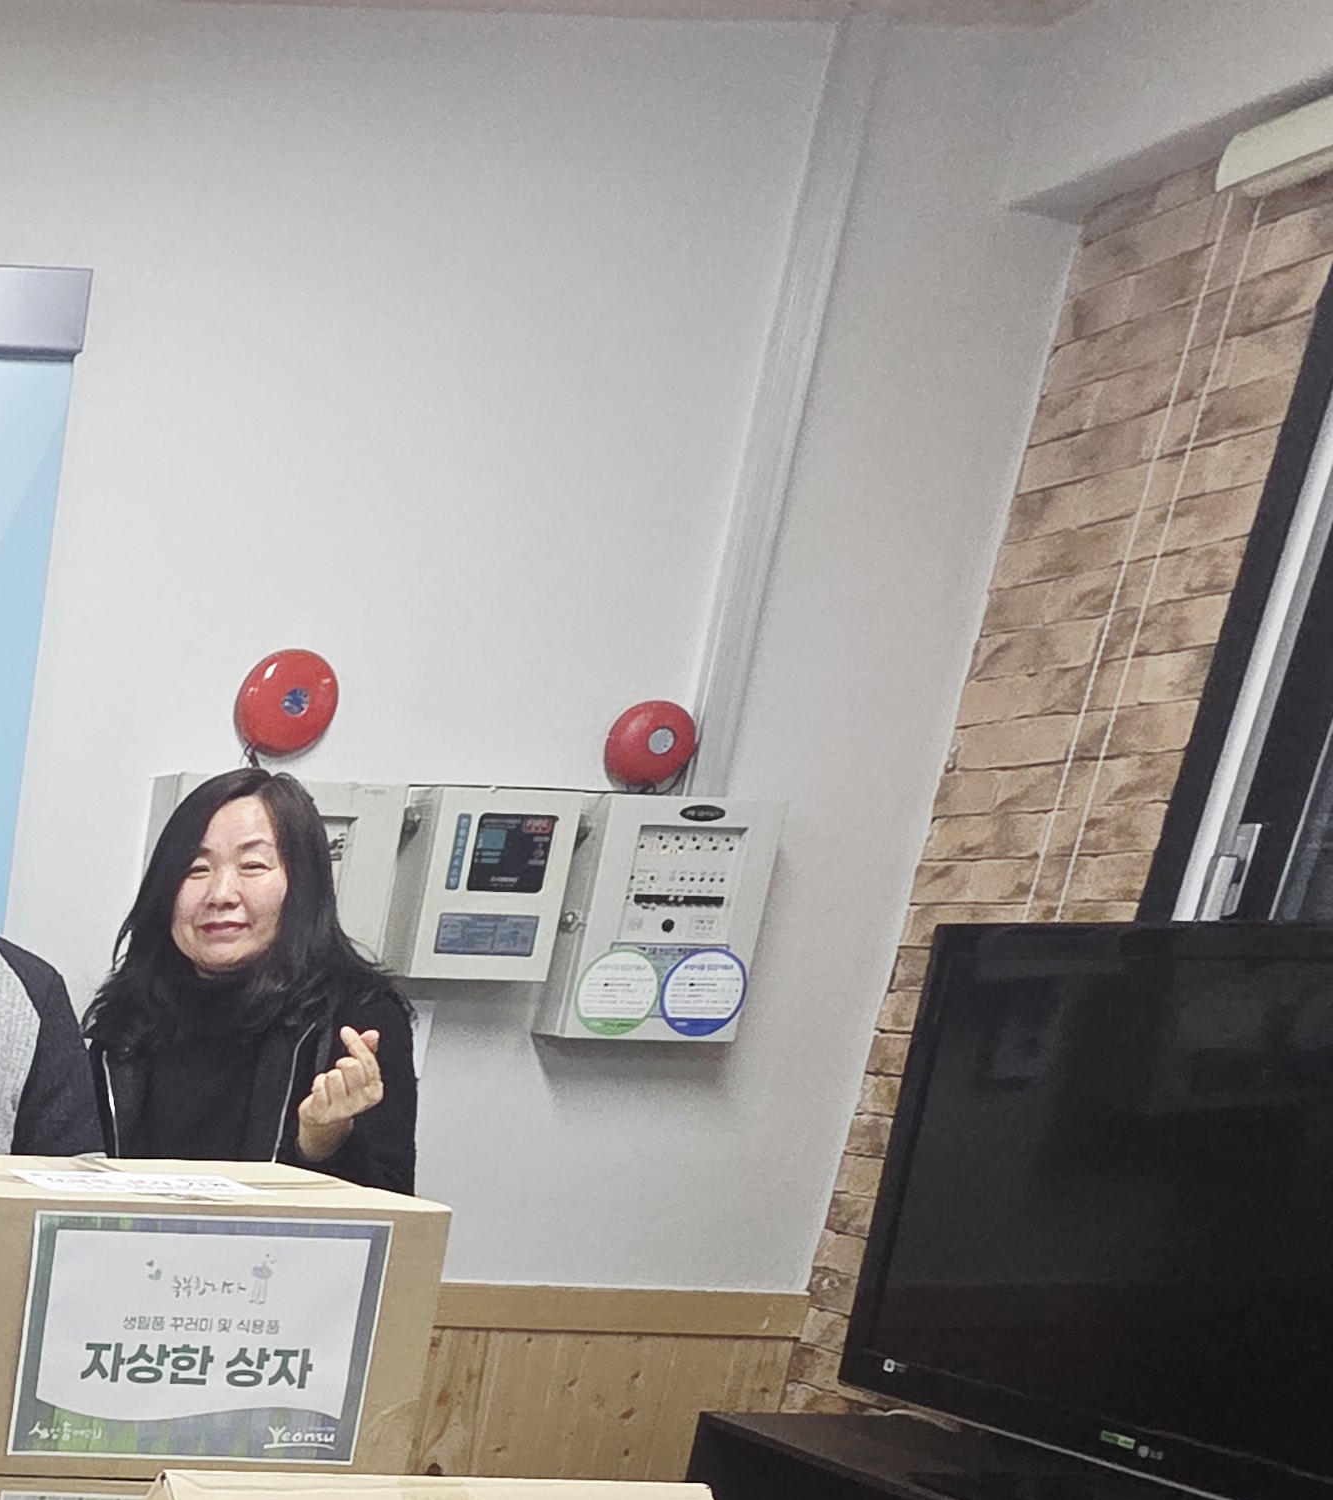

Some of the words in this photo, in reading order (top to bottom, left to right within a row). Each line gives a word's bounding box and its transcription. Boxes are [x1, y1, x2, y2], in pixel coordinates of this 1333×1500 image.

[122, 1315, 165, 1332] 생필품
[170, 1316, 213, 1333] 꾸러미
[218, 1317, 232, 1334] 및
[236, 1317, 280, 1335] 식용품
[80, 1343, 214, 1387] 자상한
[225, 1346, 313, 1390] 상자
[267, 1425, 335, 1447] Yeonsu
